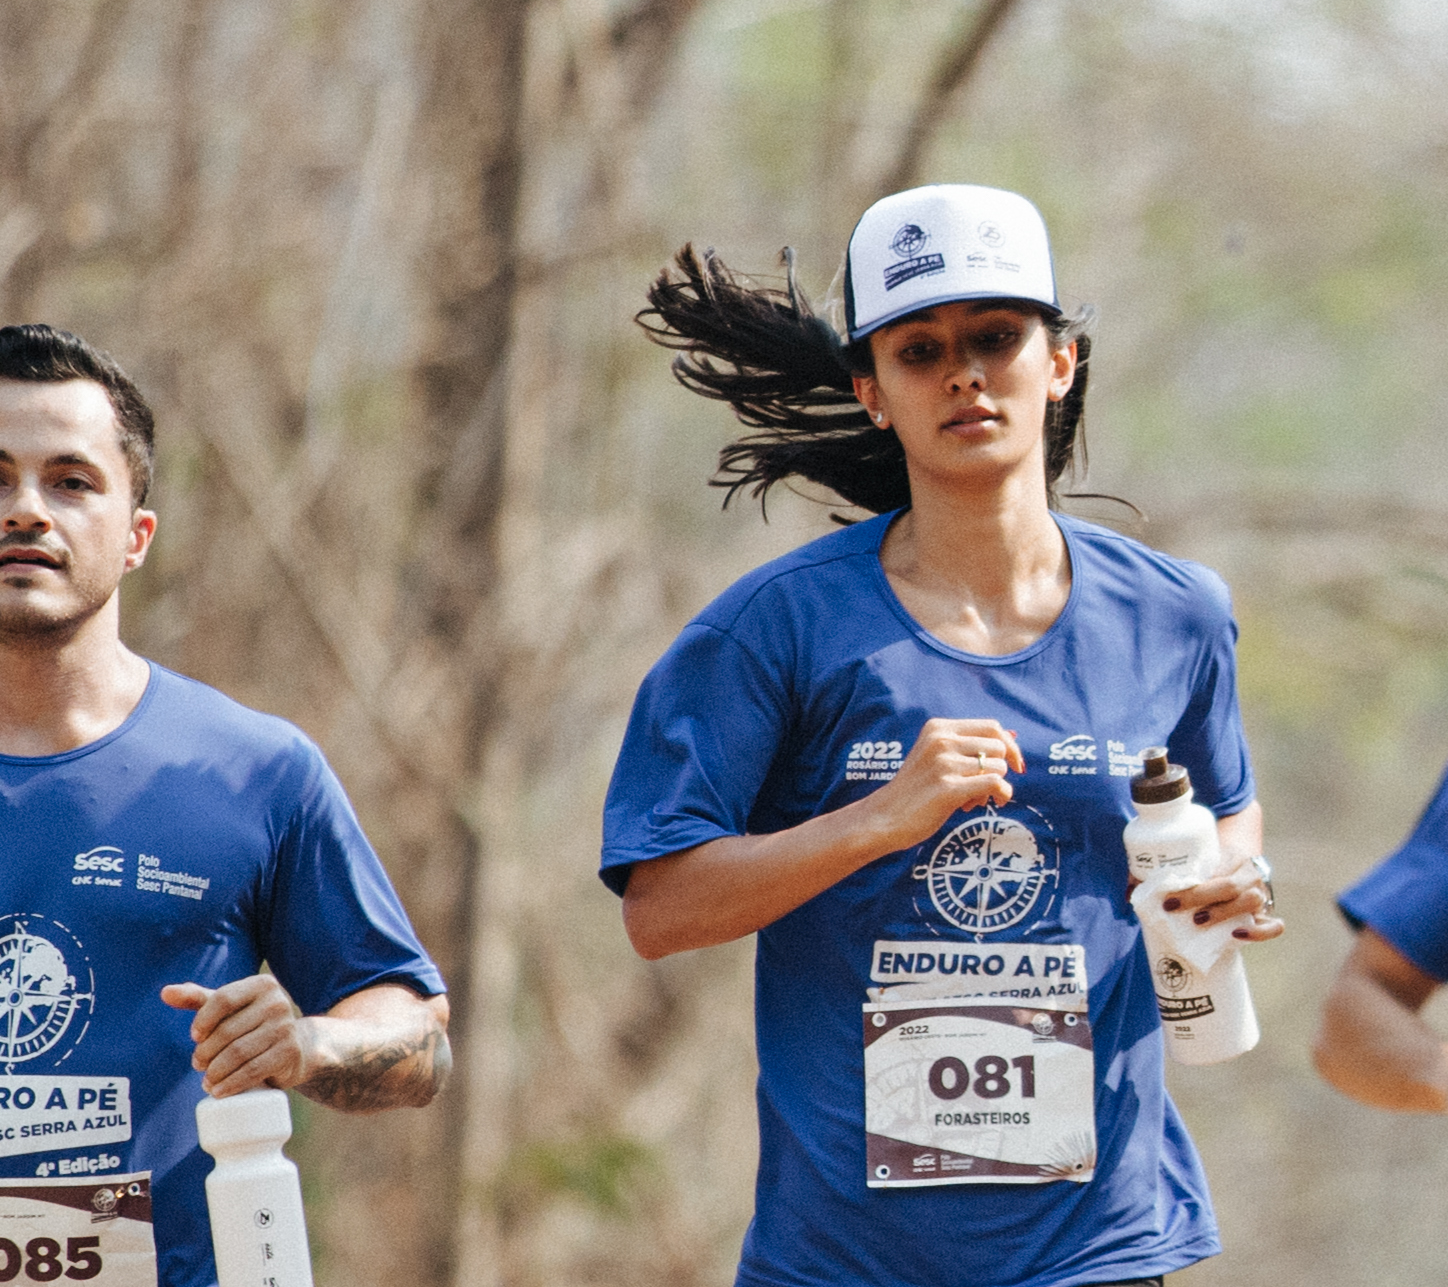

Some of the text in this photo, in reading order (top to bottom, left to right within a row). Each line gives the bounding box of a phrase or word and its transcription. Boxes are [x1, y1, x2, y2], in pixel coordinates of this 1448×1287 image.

[848, 741, 903, 759] 2022
[846, 760, 888, 770] ROSÁRIO
[868, 772, 897, 780] JARD
[138, 854, 160, 867] Polo
[137, 866, 211, 889] Socioambiental
[136, 878, 203, 900] Sesc Pantanal
[878, 950, 1076, 978] ENDURO A PÉ
[1047, 983, 1084, 996] AZUL
[899, 1025, 929, 1035] 2022
[928, 1055, 1035, 1100] 081
[45, 1088, 68, 1110] A
[78, 1082, 118, 1111] PÉ
[20, 1120, 77, 1138] SERRA
[83, 1114, 127, 1131] AZUL
[935, 1112, 1030, 1126] FORASTEIROS
[36, 1154, 121, 1177] 4ª Edição
